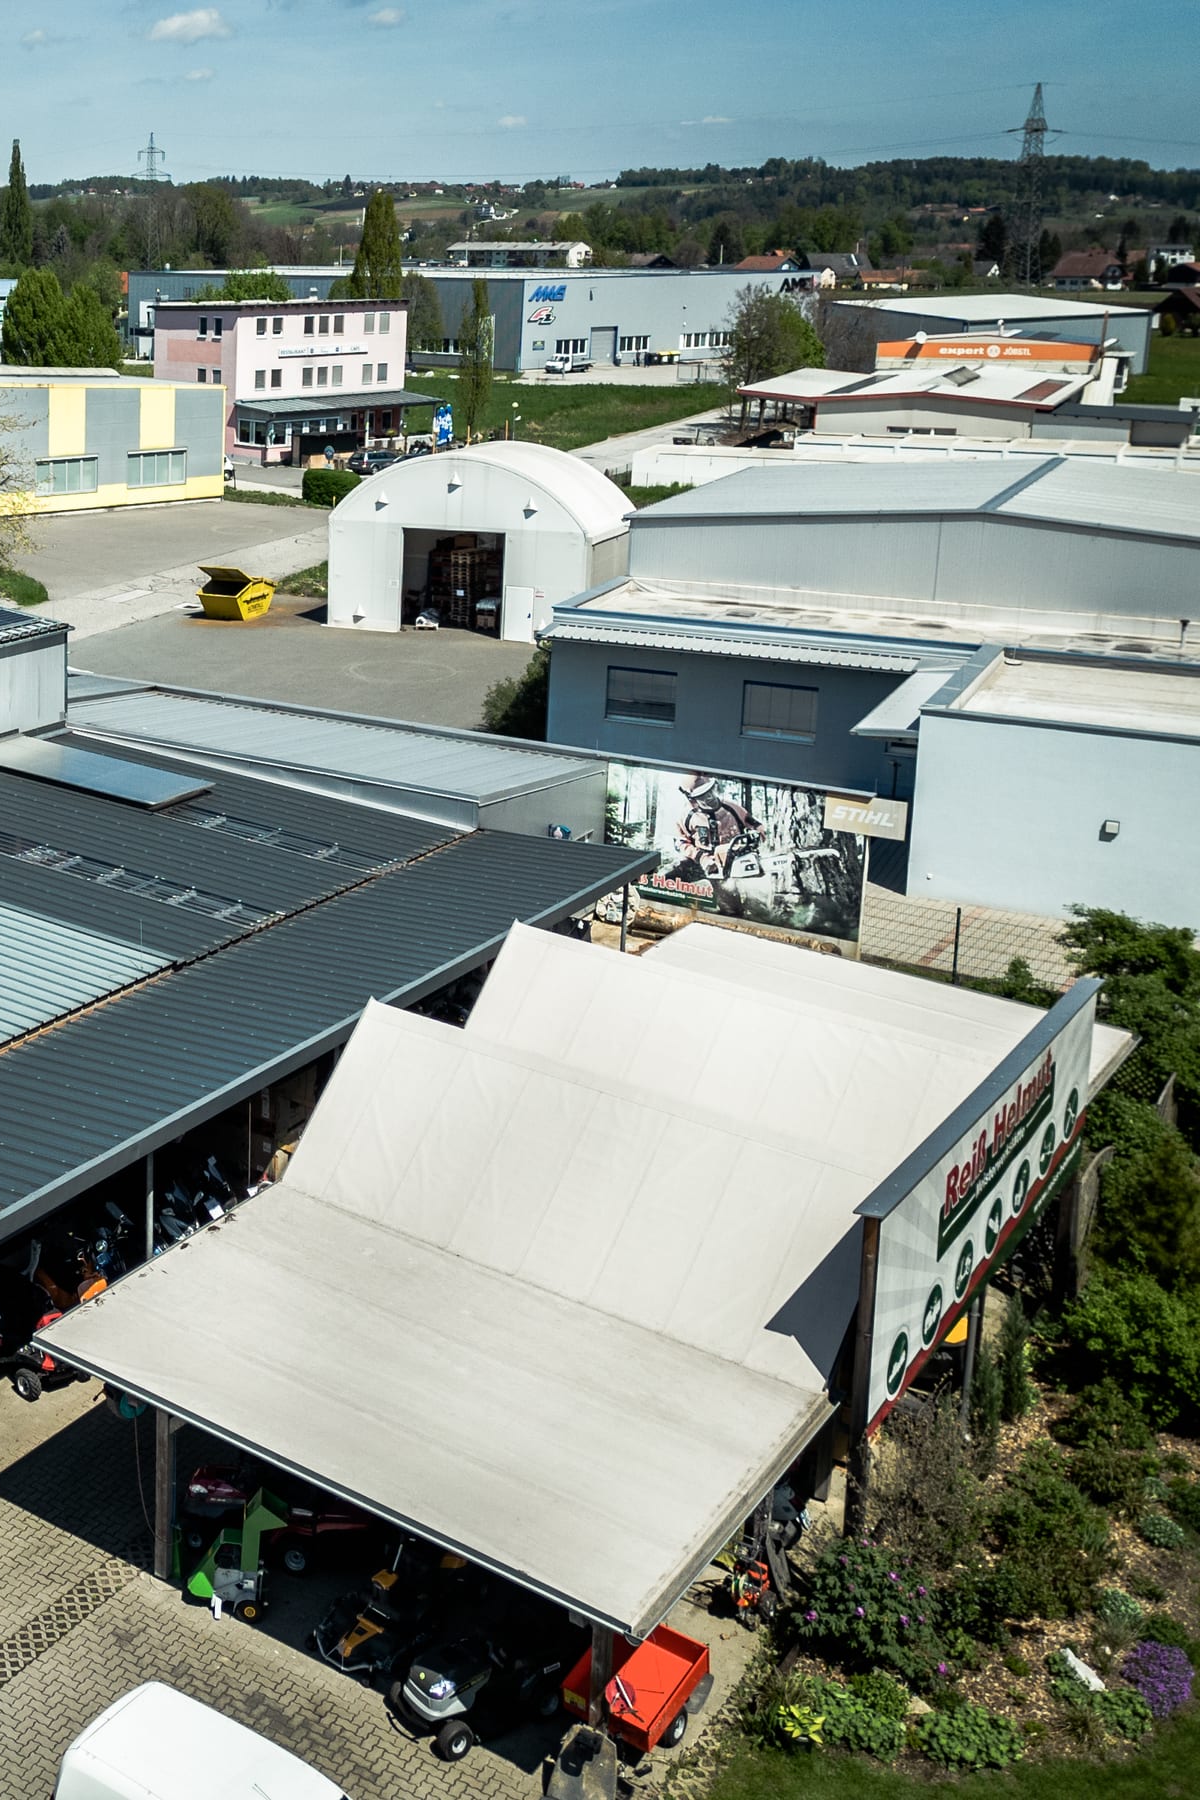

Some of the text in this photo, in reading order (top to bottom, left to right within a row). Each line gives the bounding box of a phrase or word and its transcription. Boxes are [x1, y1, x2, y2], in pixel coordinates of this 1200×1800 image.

[939, 347, 985, 355] expert
[831, 805, 895, 828] STIHL
[652, 872, 714, 899] Helmut
[943, 1047, 1054, 1219] Reiß Helmut
